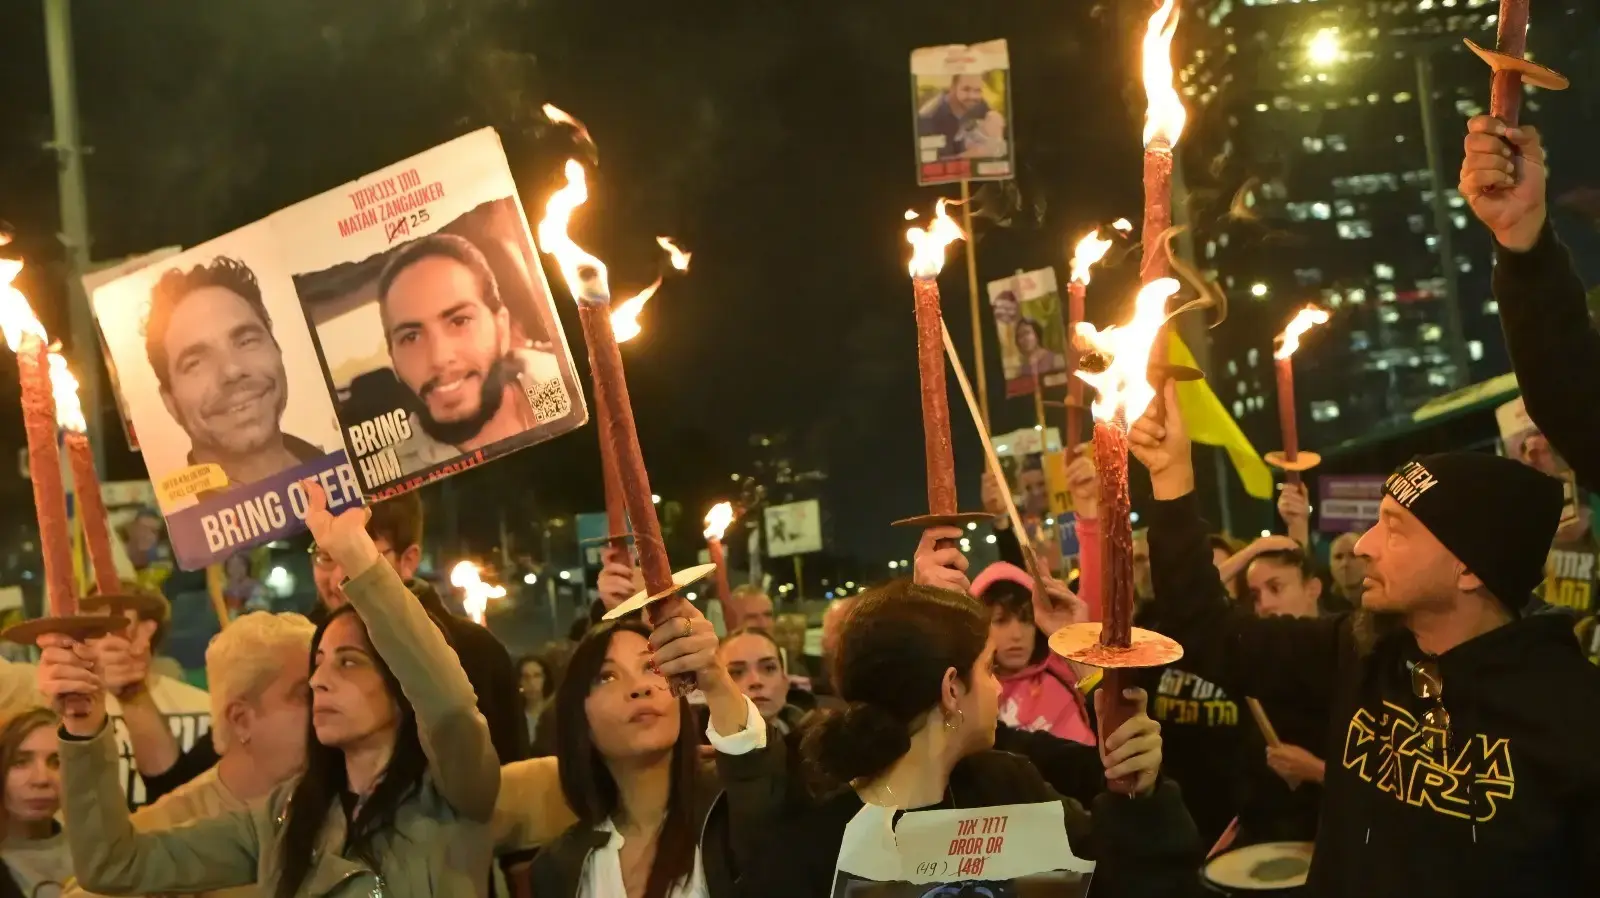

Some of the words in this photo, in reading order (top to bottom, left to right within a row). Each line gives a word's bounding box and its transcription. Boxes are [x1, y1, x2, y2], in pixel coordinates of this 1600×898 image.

[397, 168, 421, 193] מתן
[337, 207, 378, 238] MATAN
[378, 181, 445, 221] ZANGAUKER
[410, 208, 430, 228] 25
[349, 407, 412, 457] BRING
[359, 447, 402, 489] HIM
[1389, 475, 1421, 508] NOW!
[200, 490, 287, 553] BRING
[287, 463, 365, 519] OER
[1343, 719, 1515, 822] WARS
[957, 818, 977, 836] אור
[981, 815, 1009, 834] דרור
[948, 837, 982, 856] DROR
[985, 836, 1004, 854] OR
[957, 857, 985, 878] (48)
